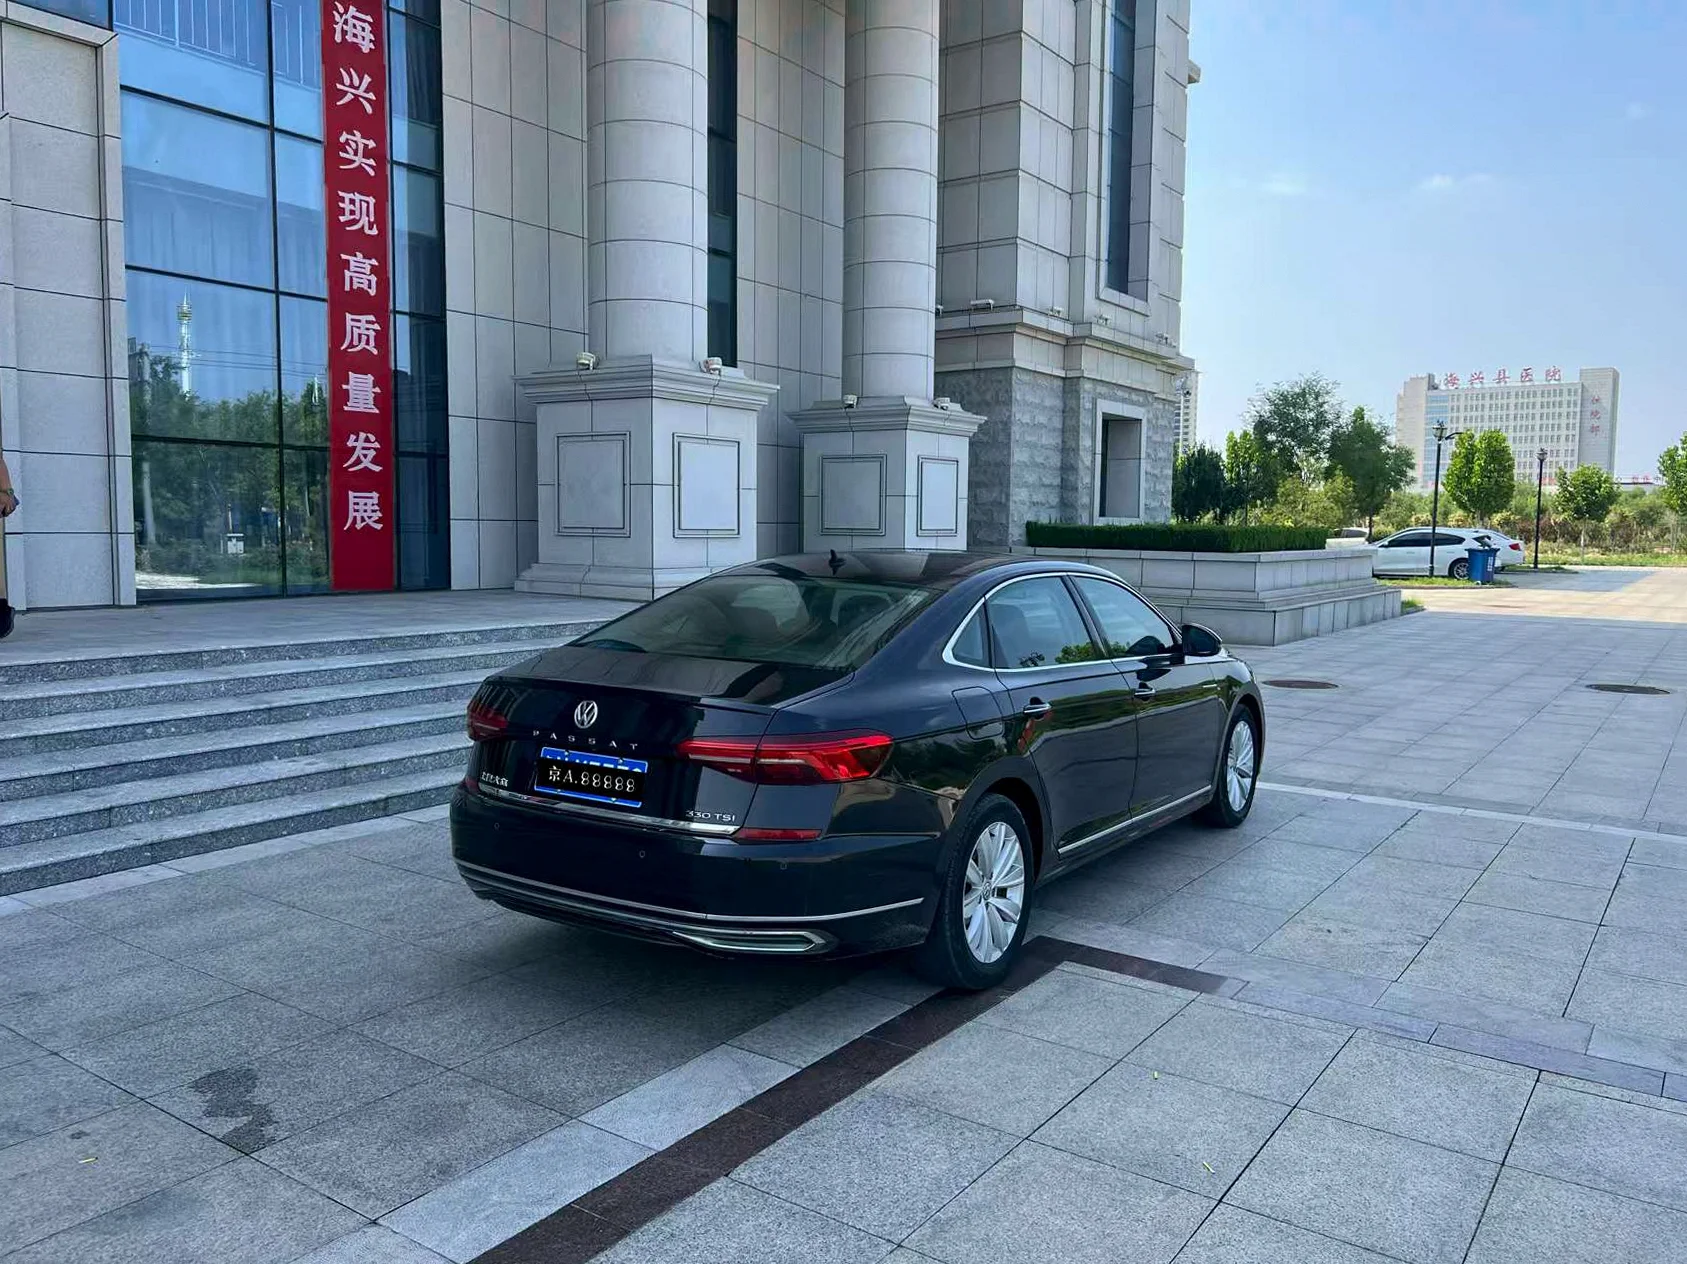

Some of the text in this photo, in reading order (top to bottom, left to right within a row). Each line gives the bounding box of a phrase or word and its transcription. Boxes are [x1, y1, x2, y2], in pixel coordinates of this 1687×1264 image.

[334, 1, 384, 531] 海兴实现高质量发展
[1443, 365, 1562, 390] 海兴县医院
[533, 730, 638, 750] PASSAT
[685, 809, 736, 822] 330 TSI
